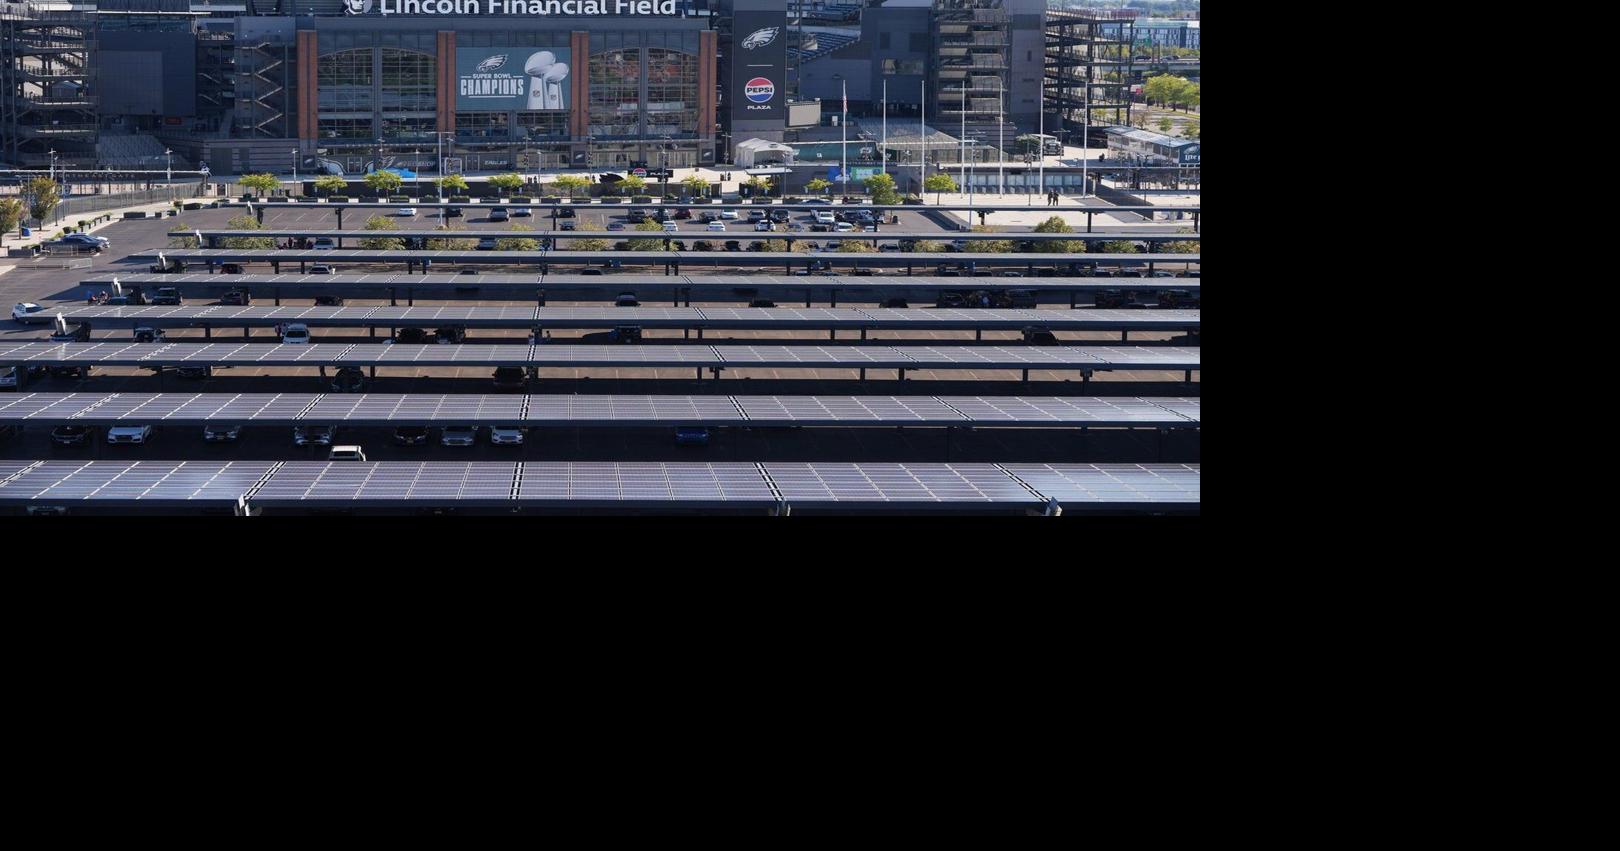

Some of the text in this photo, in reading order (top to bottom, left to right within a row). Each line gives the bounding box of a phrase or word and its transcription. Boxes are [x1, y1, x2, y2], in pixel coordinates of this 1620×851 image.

[381, 0, 676, 15] Lincoln Financial Field
[460, 79, 524, 96] CHAMPIONS
